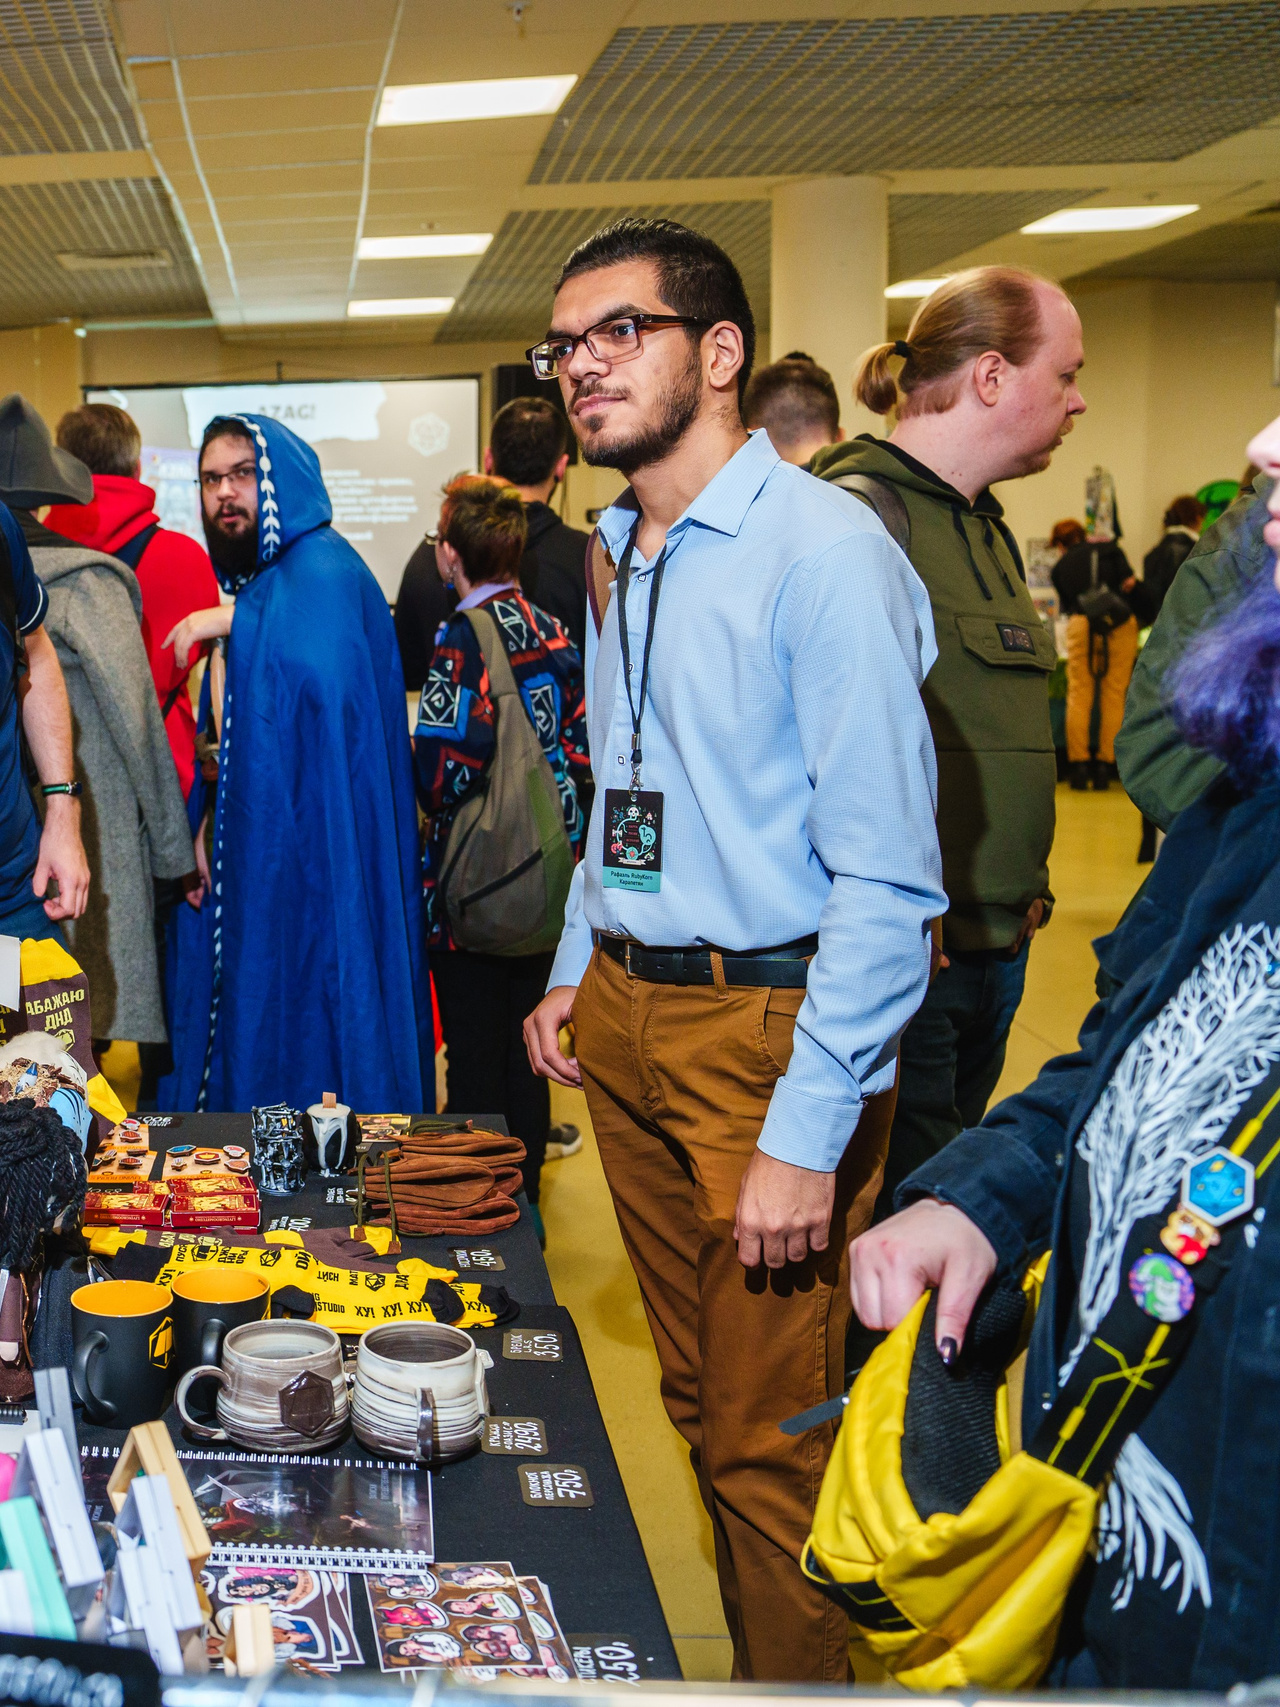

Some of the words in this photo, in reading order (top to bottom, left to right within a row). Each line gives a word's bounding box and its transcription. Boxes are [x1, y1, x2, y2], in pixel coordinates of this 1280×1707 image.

[610, 870, 630, 879] Рафаэль
[45, 1007, 73, 1031] ДНД
[295, 1251, 312, 1270] ОЙ
[316, 1270, 339, 1283] НЭЙТ
[355, 1306, 376, 1319] ХУ!
[382, 1302, 404, 1318] ХУ!
[406, 1301, 429, 1314] ХУ!
[524, 1471, 543, 1499] БЛОКНОТ
[540, 1470, 555, 1501] ПЕРСОНАЖА
